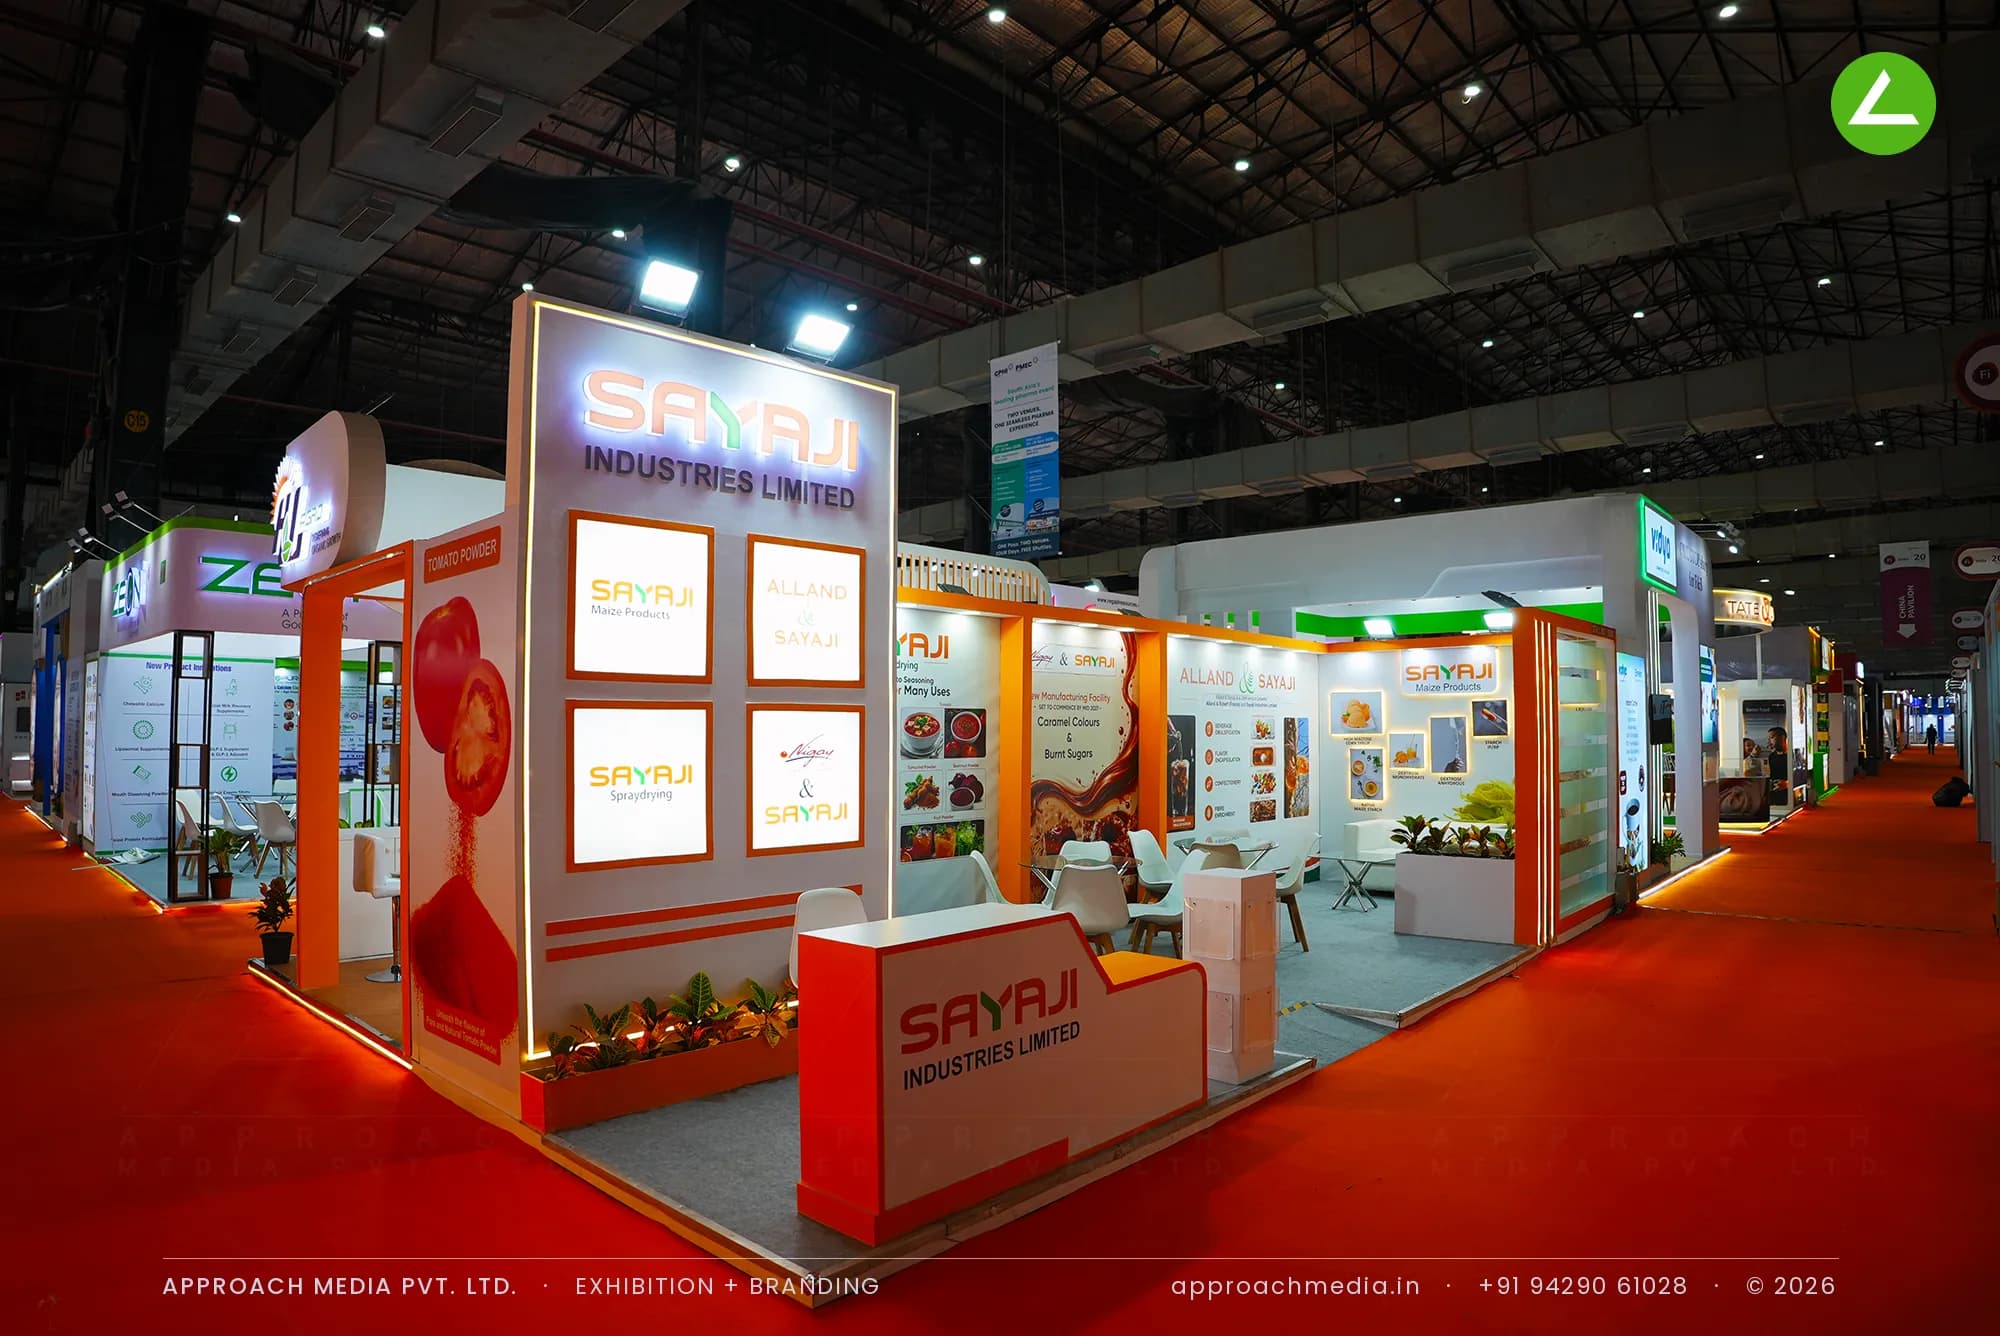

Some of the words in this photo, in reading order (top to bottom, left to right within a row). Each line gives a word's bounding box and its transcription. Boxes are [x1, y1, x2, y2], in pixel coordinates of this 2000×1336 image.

[1038, 386, 1055, 394] event
[583, 370, 860, 472] SAYAJI
[1006, 416, 1031, 427] SEAMLESS
[1032, 410, 1054, 420] PHARMA
[1007, 411, 1019, 419] TWO
[1009, 421, 1039, 432] EXPERIENCE
[585, 444, 753, 494] INDUSTRIES
[762, 474, 855, 508] LIMITED
[428, 551, 459, 572] TOMATO
[460, 539, 497, 563] POWDER
[591, 579, 693, 608] SAYAJI
[767, 579, 847, 600] ALLAND
[1728, 601, 1759, 615] TATE
[1899, 595, 1907, 619] CHINA
[1907, 584, 1916, 619] PAVILION
[591, 605, 623, 618] Maize
[625, 607, 670, 620] Products
[798, 610, 816, 626] &
[774, 630, 838, 648] SAYAJI
[896, 632, 949, 659] YAJI
[146, 662, 162, 670] New
[1060, 652, 1068, 666] &
[1075, 654, 1114, 668] SAYAJI
[904, 675, 935, 686] Seasoning
[1180, 667, 1234, 686] ALLAND
[1258, 674, 1296, 691] SAYAJI
[1406, 663, 1492, 681] SAYAJI
[904, 686, 929, 698] Many
[931, 687, 951, 697] Uses
[1415, 683, 1441, 692] Maize
[1443, 682, 1482, 692] Products
[1041, 692, 1088, 704] Manufacturing
[1089, 693, 1111, 704] Facility
[1037, 716, 1070, 727] Caramel
[1072, 717, 1100, 727] Colours
[1066, 733, 1072, 743] &
[1044, 749, 1065, 759] Burnt
[1067, 749, 1093, 760] Sugars
[590, 765, 692, 787] SAYAJI
[610, 789, 673, 804] Spraydrying
[799, 778, 814, 798] &
[765, 802, 848, 825] SAYAJI
[900, 968, 1078, 1055] SAYAJI
[903, 1041, 1014, 1091] INDUSTRIES
[1019, 1020, 1081, 1057] LIMITED
